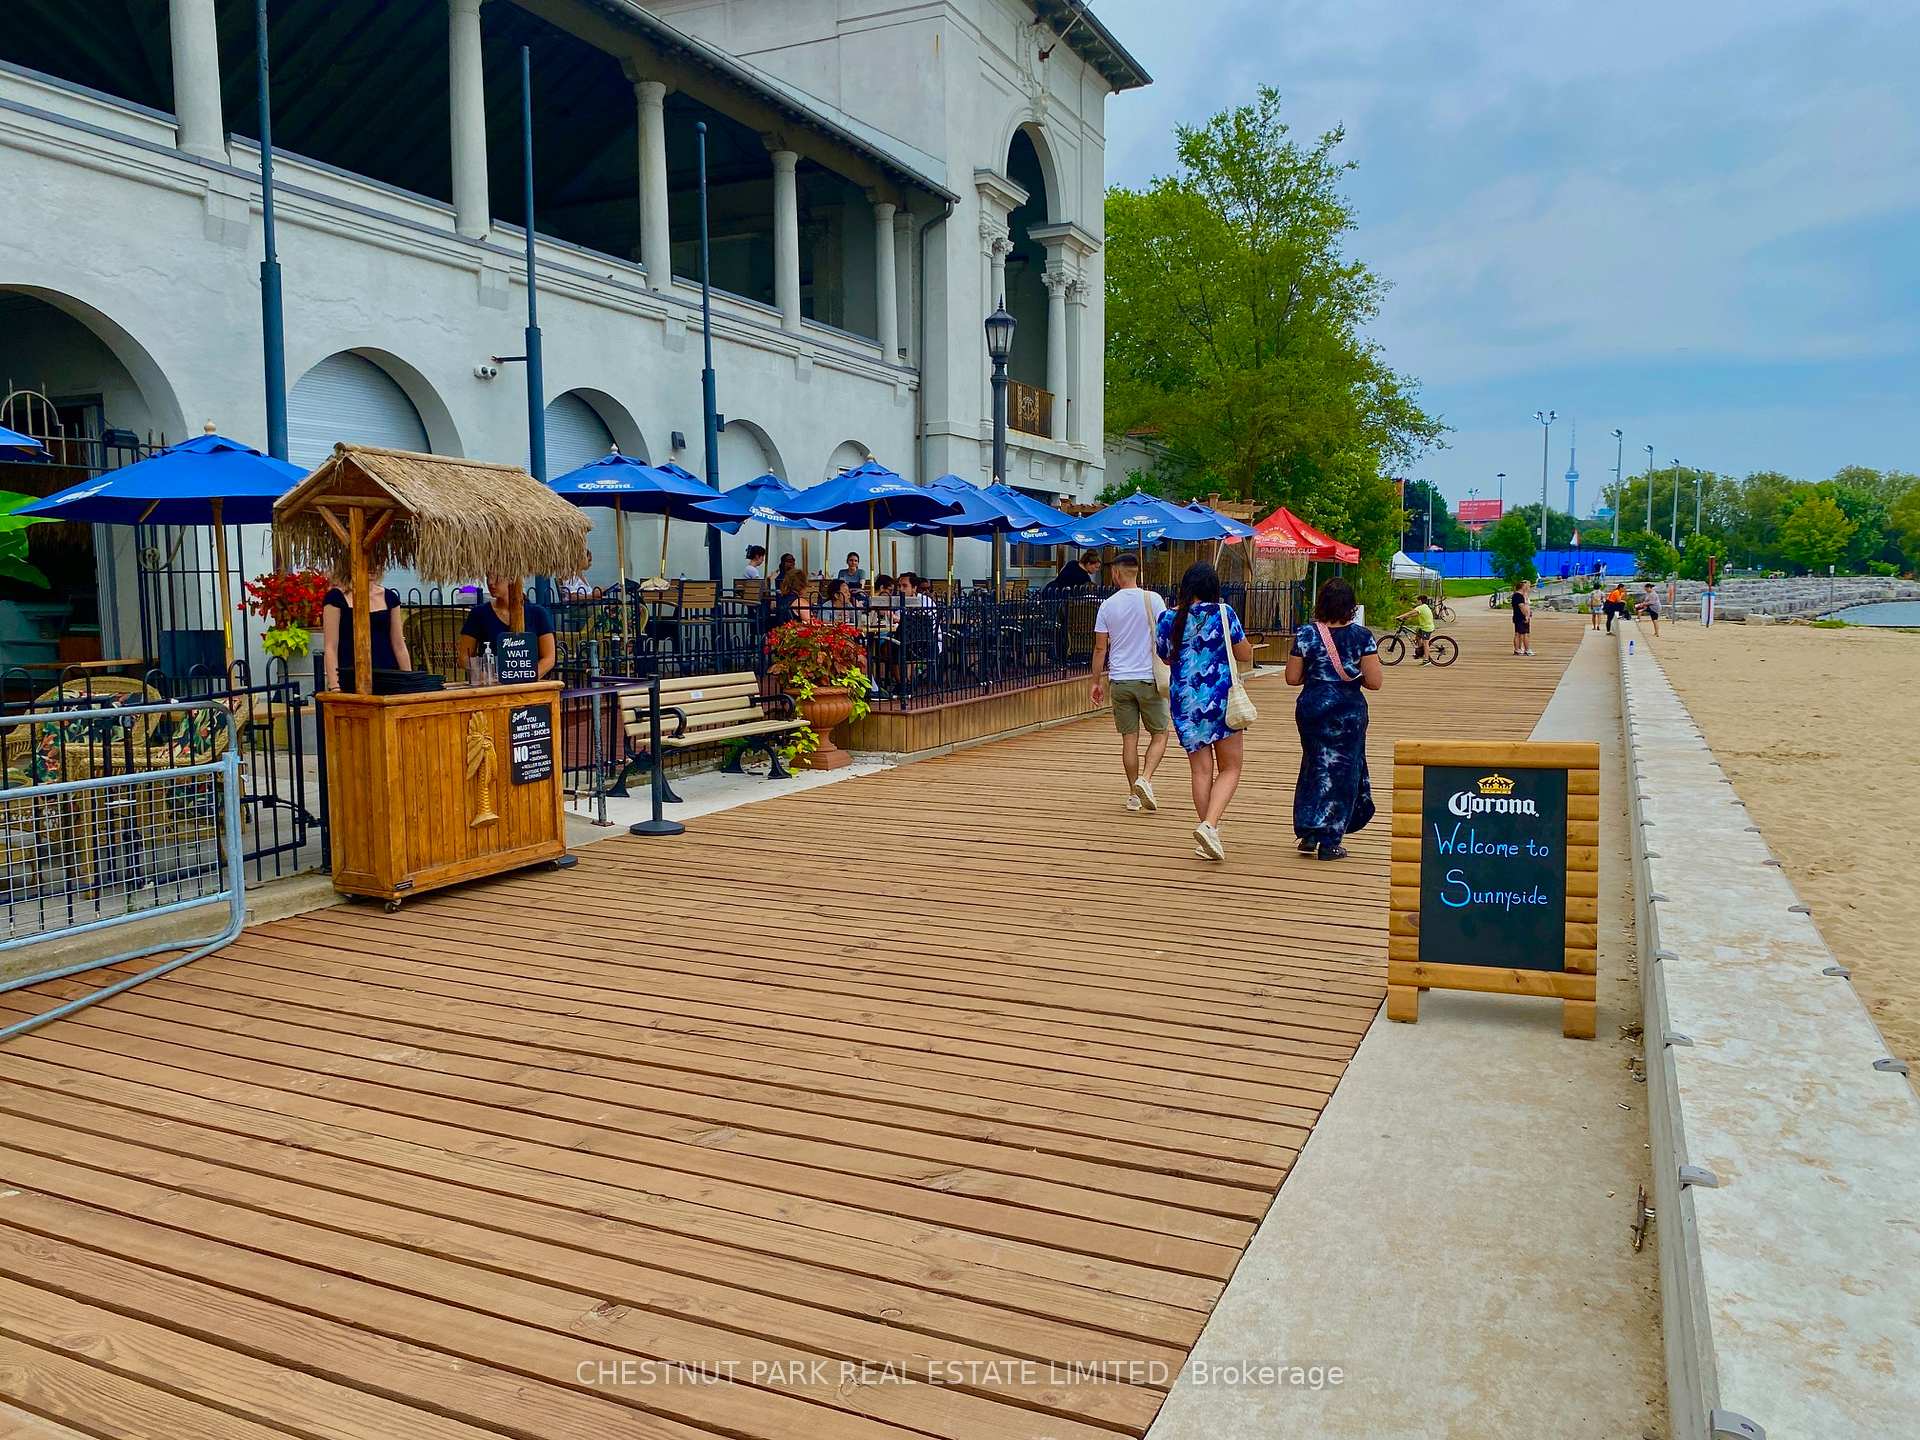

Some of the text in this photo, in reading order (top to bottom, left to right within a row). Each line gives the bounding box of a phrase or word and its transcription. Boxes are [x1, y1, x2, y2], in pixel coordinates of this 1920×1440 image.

[502, 637, 526, 648] Please
[507, 650, 529, 658] WAIT
[505, 660, 532, 668] TO BE
[501, 670, 536, 679] SEATED
[530, 721, 546, 729] WEAR
[512, 731, 530, 740] SHIRTS
[533, 728, 550, 736] SHOES
[513, 745, 529, 763] NO
[1434, 822, 1550, 858] Welcome to
[1440, 868, 1549, 912] Sunnyside
